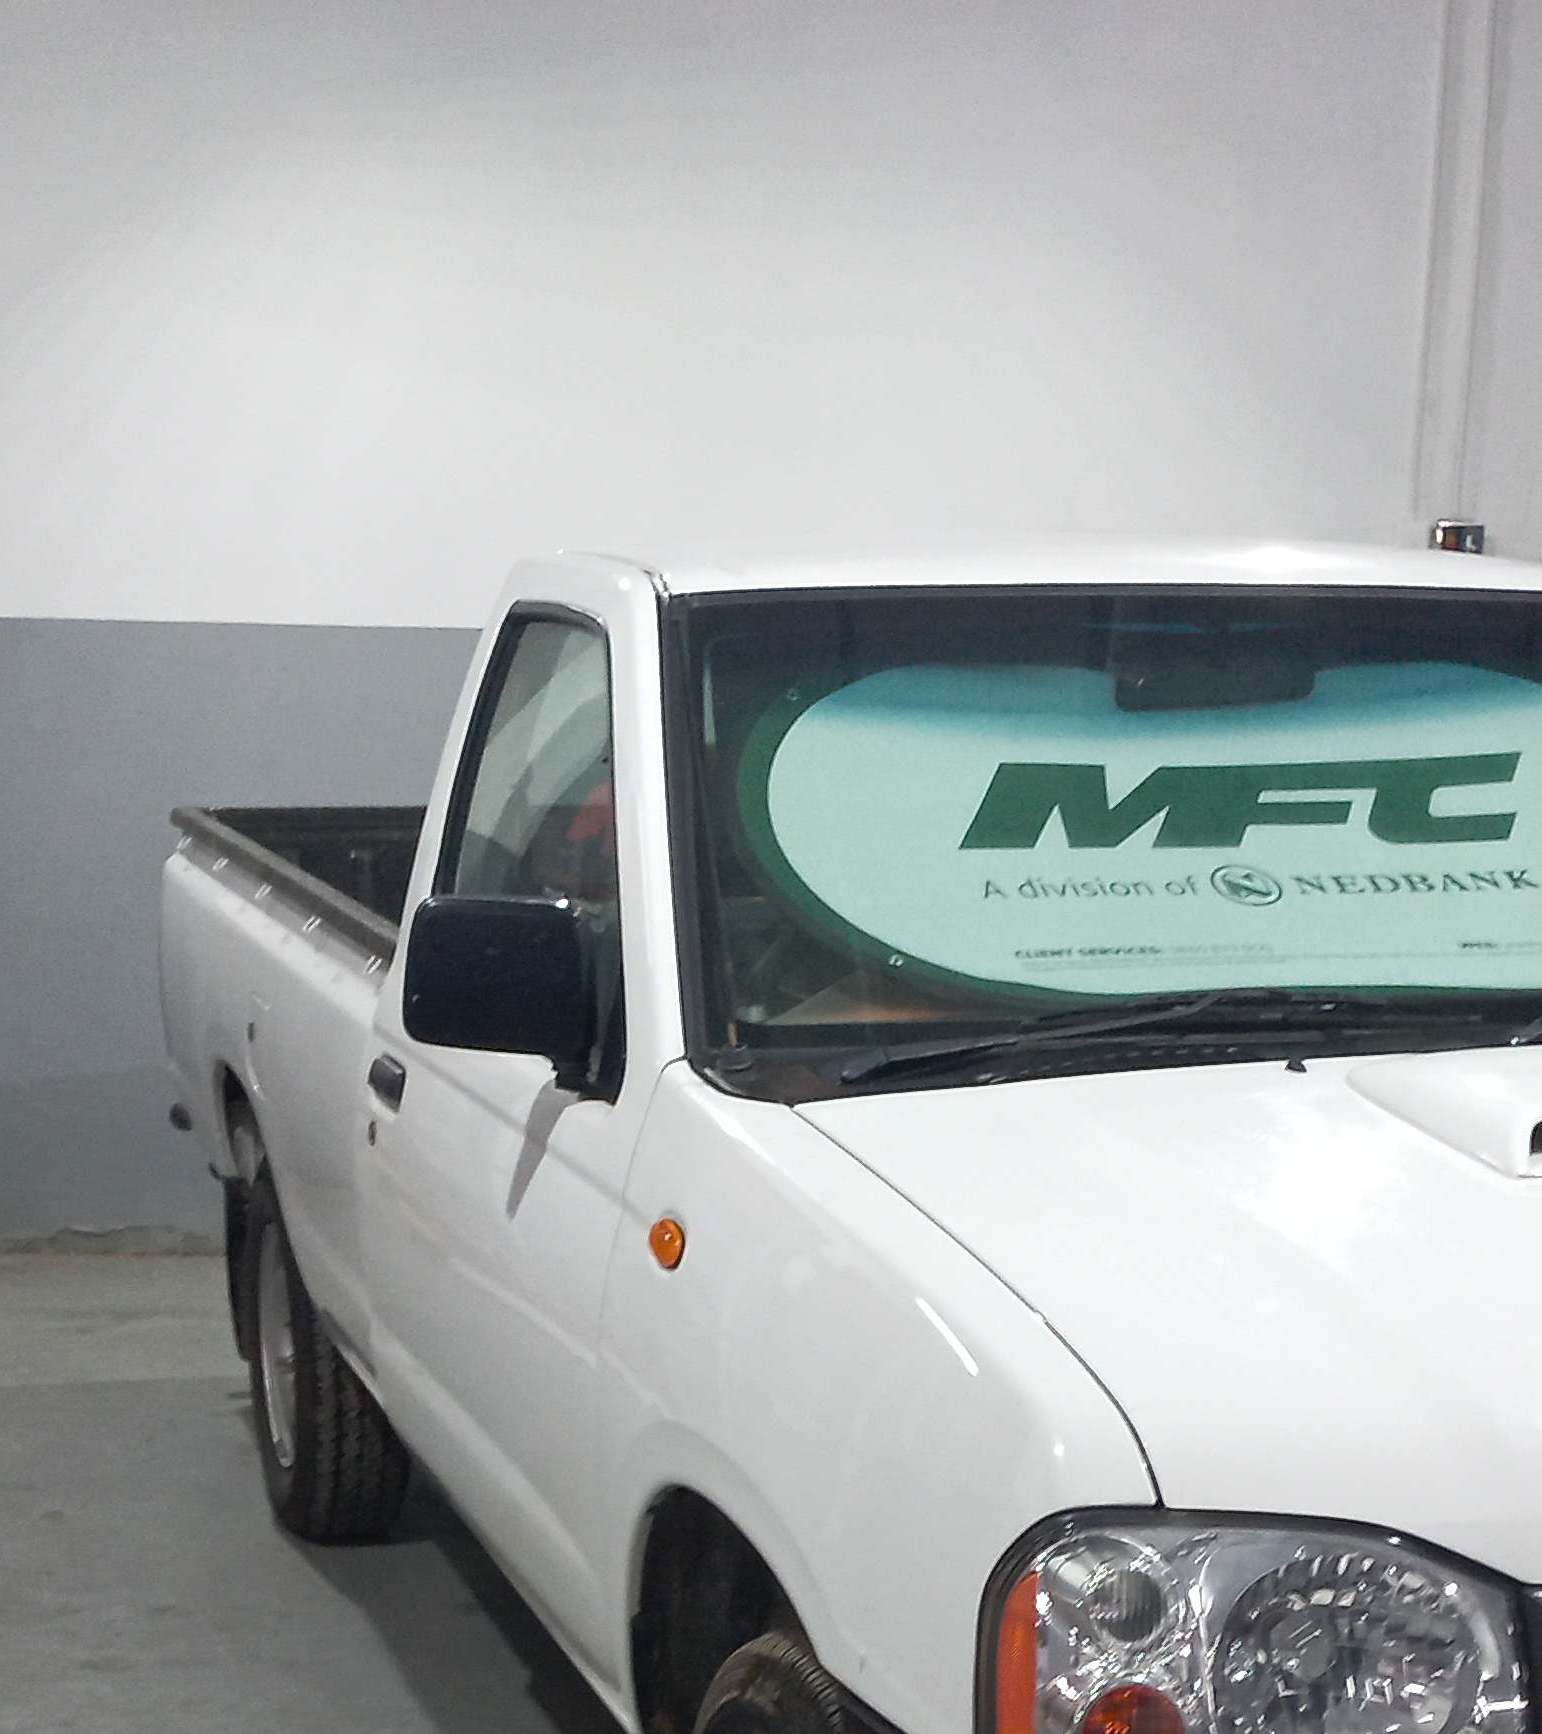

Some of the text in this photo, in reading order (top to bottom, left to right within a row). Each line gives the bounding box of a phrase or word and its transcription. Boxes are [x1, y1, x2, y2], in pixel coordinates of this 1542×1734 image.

[958, 751, 1523, 850] MFC
[983, 869, 1541, 899] A division of NEDBANK
